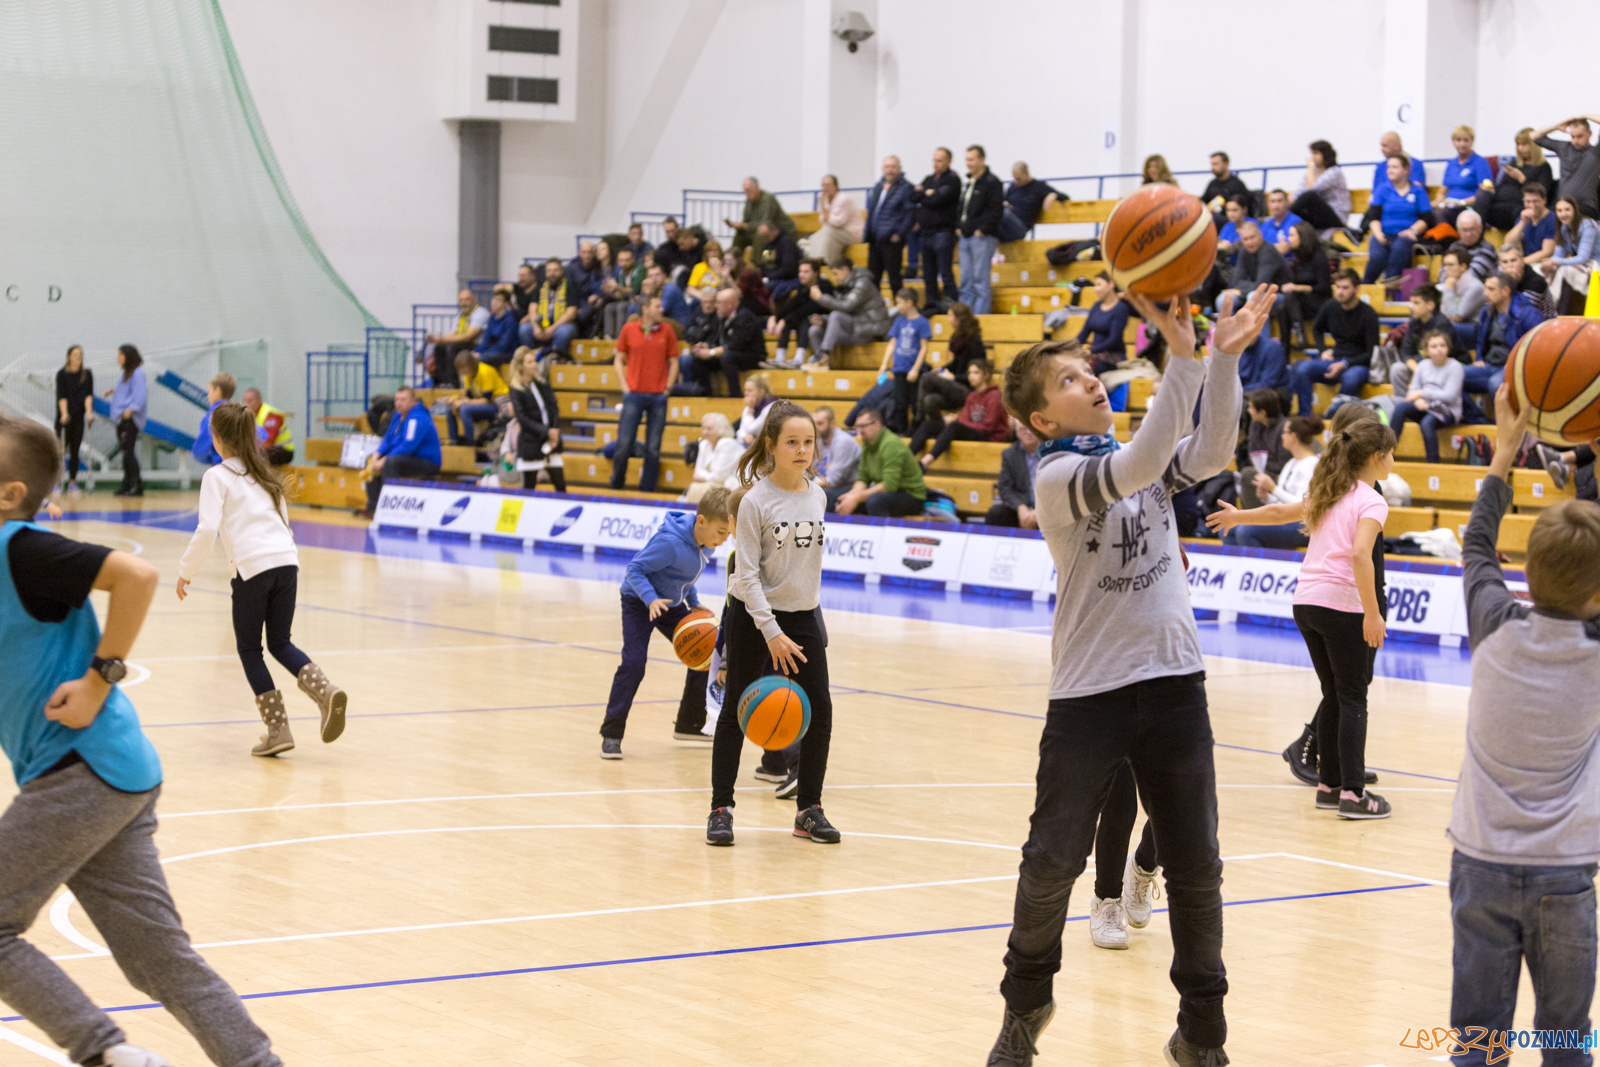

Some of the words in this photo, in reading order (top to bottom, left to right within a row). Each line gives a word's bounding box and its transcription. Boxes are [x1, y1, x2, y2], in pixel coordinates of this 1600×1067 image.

[1397, 103, 1411, 124] C
[1103, 131, 1116, 149] D
[6, 284, 19, 302] C
[48, 285, 62, 302] D
[380, 494, 425, 512] BIOFARM
[1086, 506, 1107, 533] THE
[822, 537, 874, 560] NICKEL
[1132, 552, 1172, 591] EDITION
[1186, 566, 1227, 590] ARM
[1239, 571, 1299, 596] BIOFA
[1385, 587, 1431, 623] PBG
